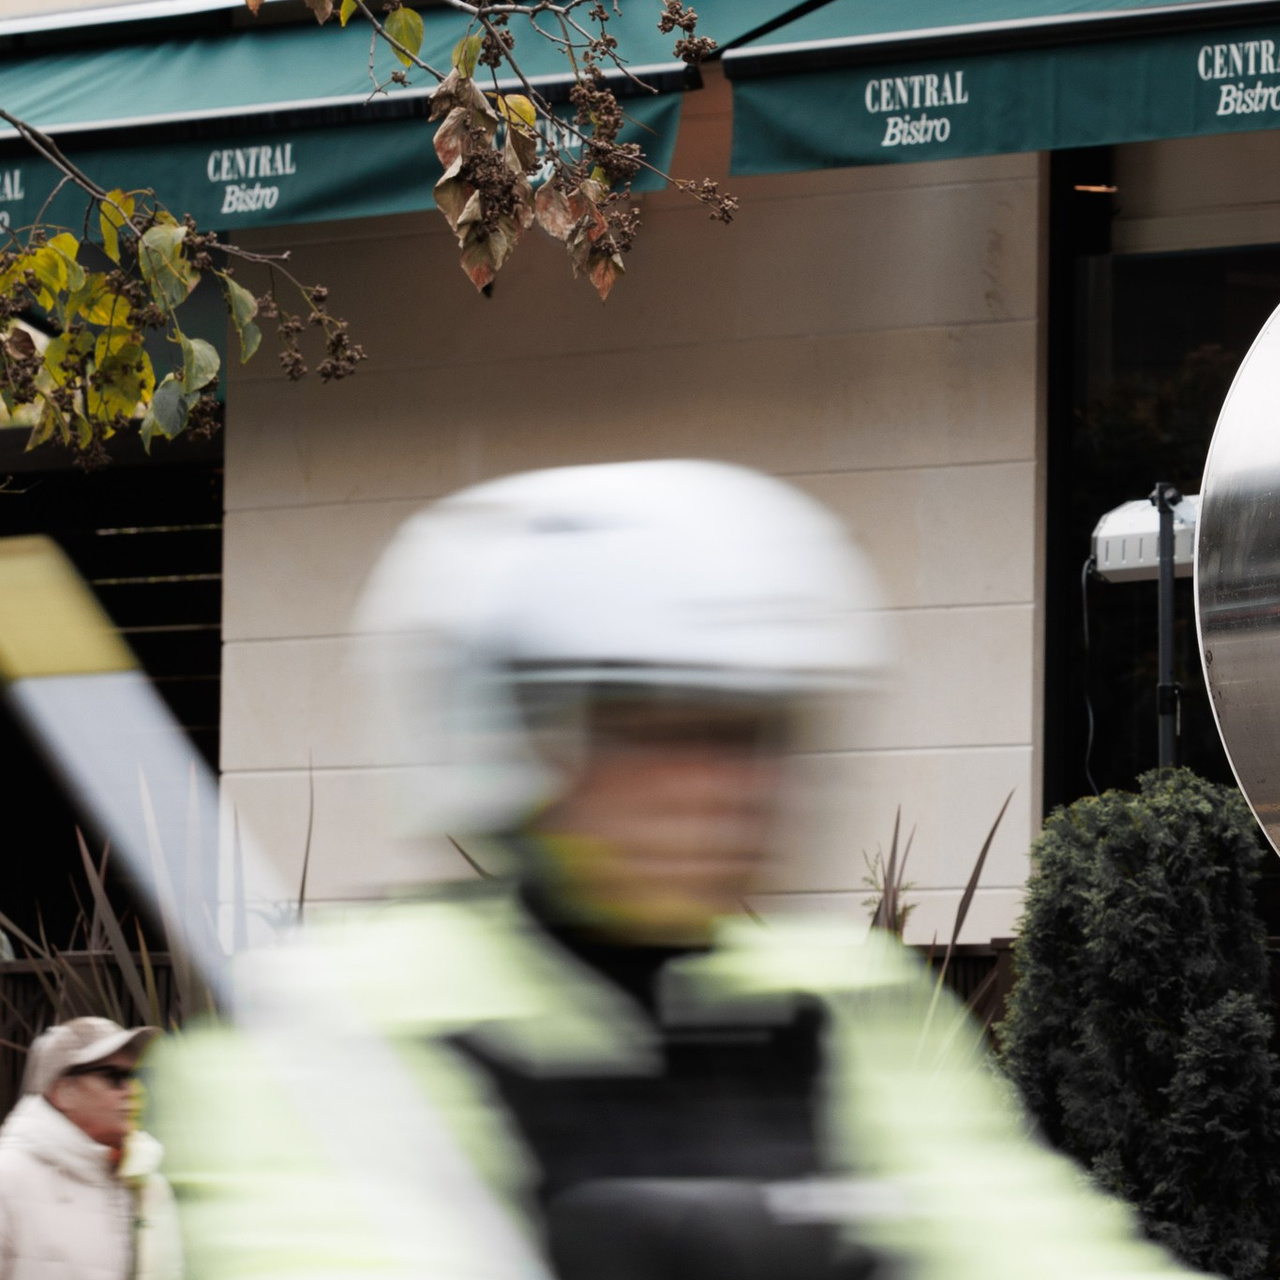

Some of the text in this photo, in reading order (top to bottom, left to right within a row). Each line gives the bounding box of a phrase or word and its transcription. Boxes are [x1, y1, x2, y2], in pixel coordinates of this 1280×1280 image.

[865, 71, 969, 113] CENTRAL
[881, 113, 951, 147] Bistro
[207, 143, 296, 182] CENTRAL
[221, 183, 279, 214] Bistro
